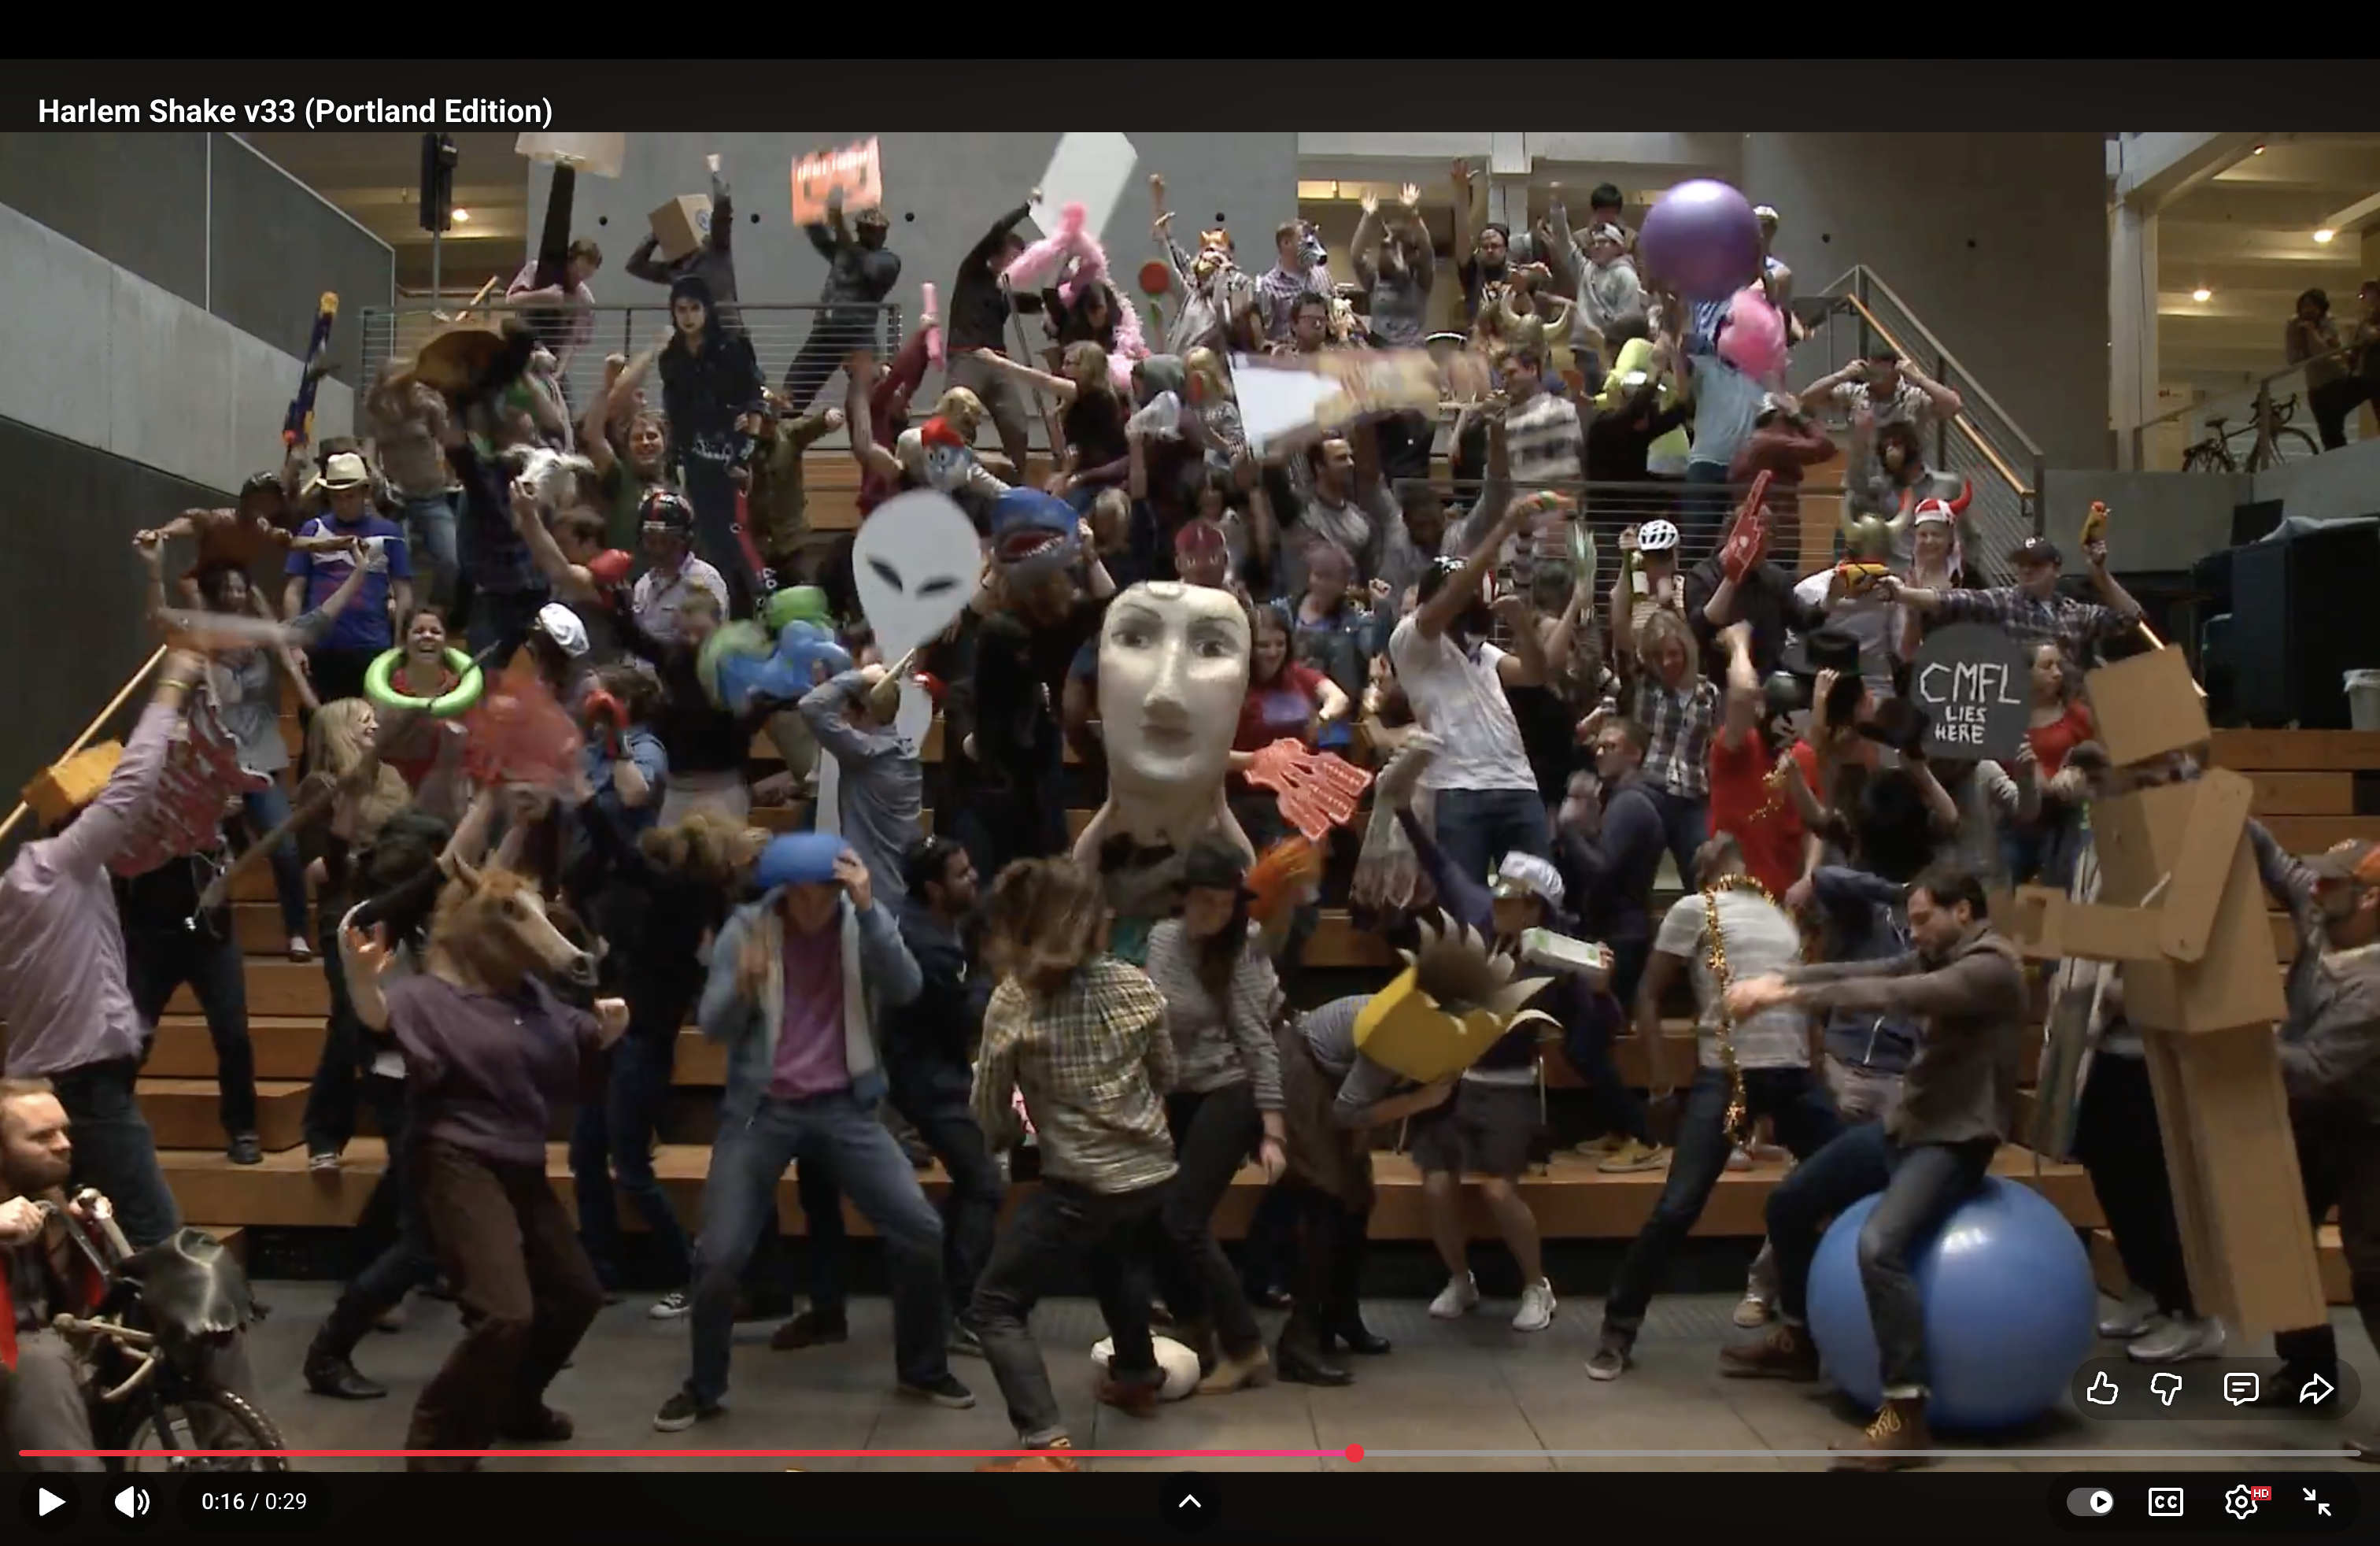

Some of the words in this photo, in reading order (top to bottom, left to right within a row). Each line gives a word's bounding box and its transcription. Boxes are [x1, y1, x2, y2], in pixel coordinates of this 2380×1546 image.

[1920, 661, 2021, 705] CMFL
[1945, 705, 1987, 722] LIES
[1935, 723, 1984, 744] HERE
